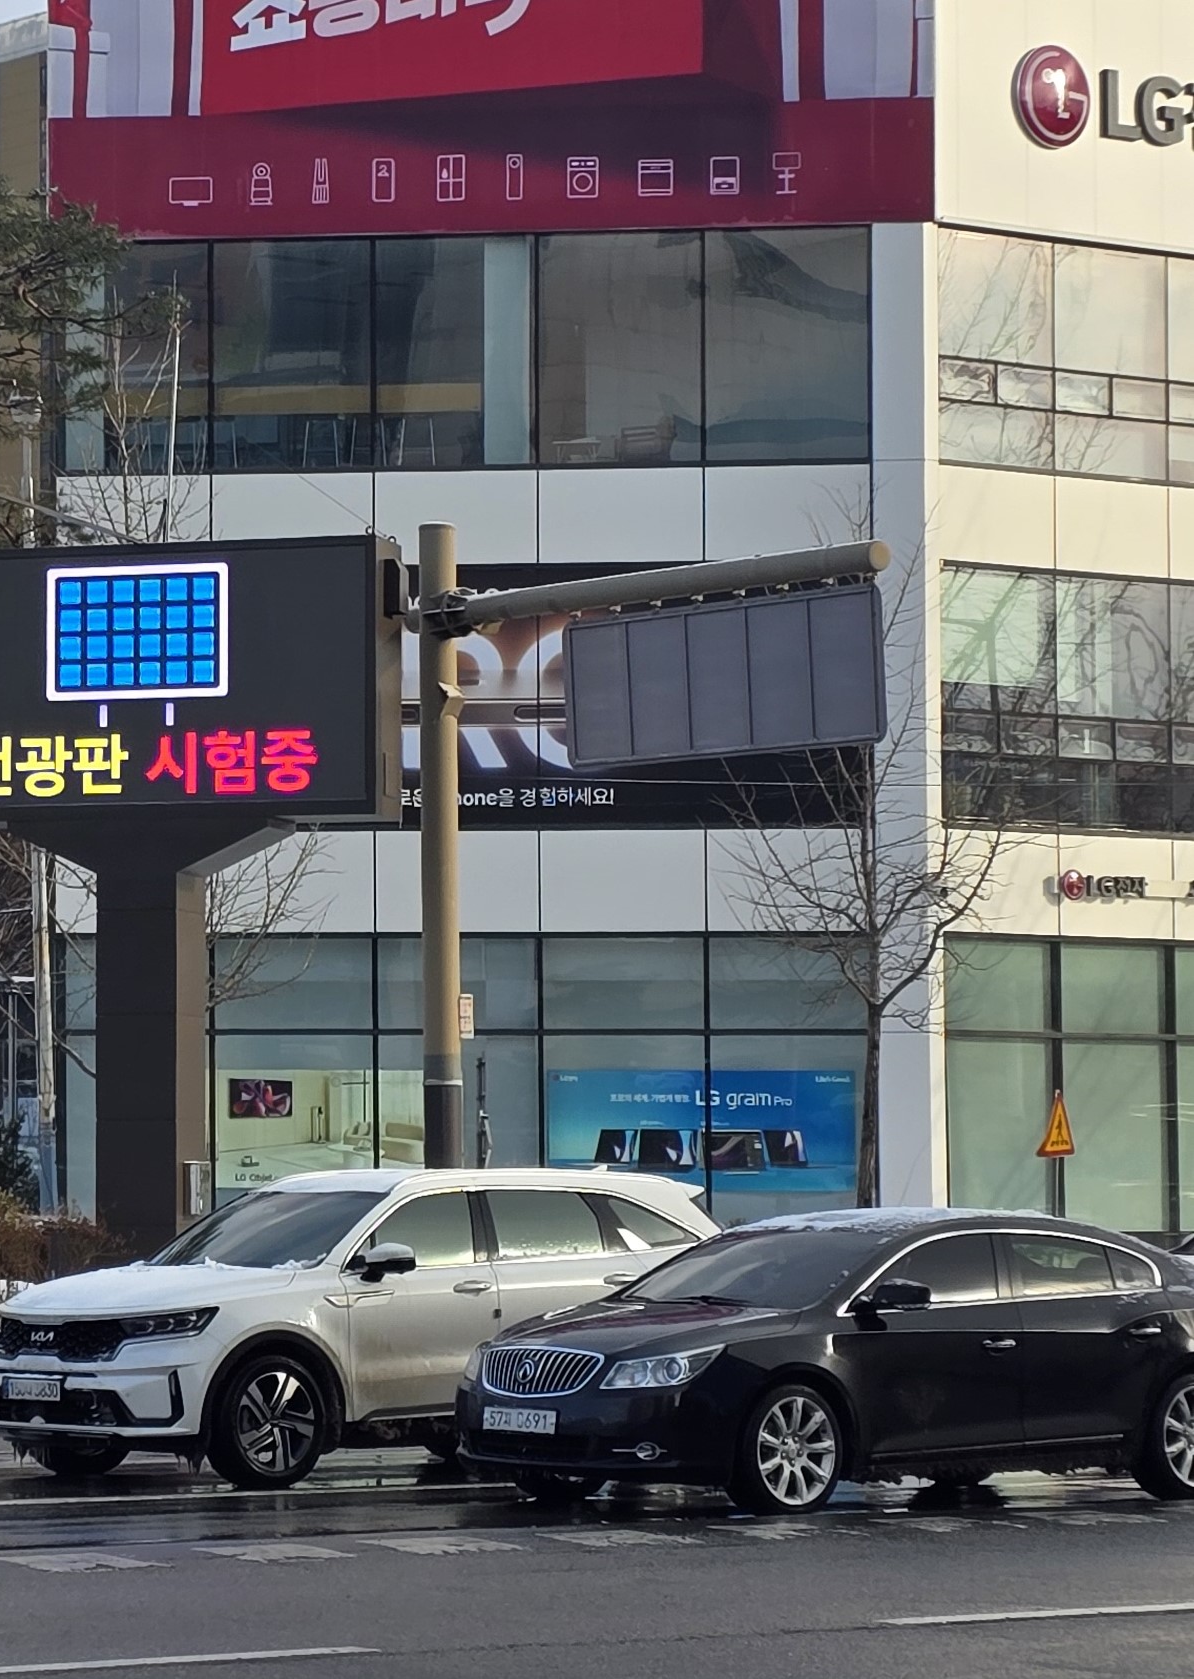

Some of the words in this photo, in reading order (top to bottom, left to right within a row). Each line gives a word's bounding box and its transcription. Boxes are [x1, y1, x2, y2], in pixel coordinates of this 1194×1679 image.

[1099, 69, 1194, 150] LG
[145, 728, 320, 795] 시험중
[519, 786, 615, 808] 경험하세요!
[695, 1090, 720, 1106] LG
[726, 1091, 772, 1110] gram
[773, 1096, 793, 1106] Pro
